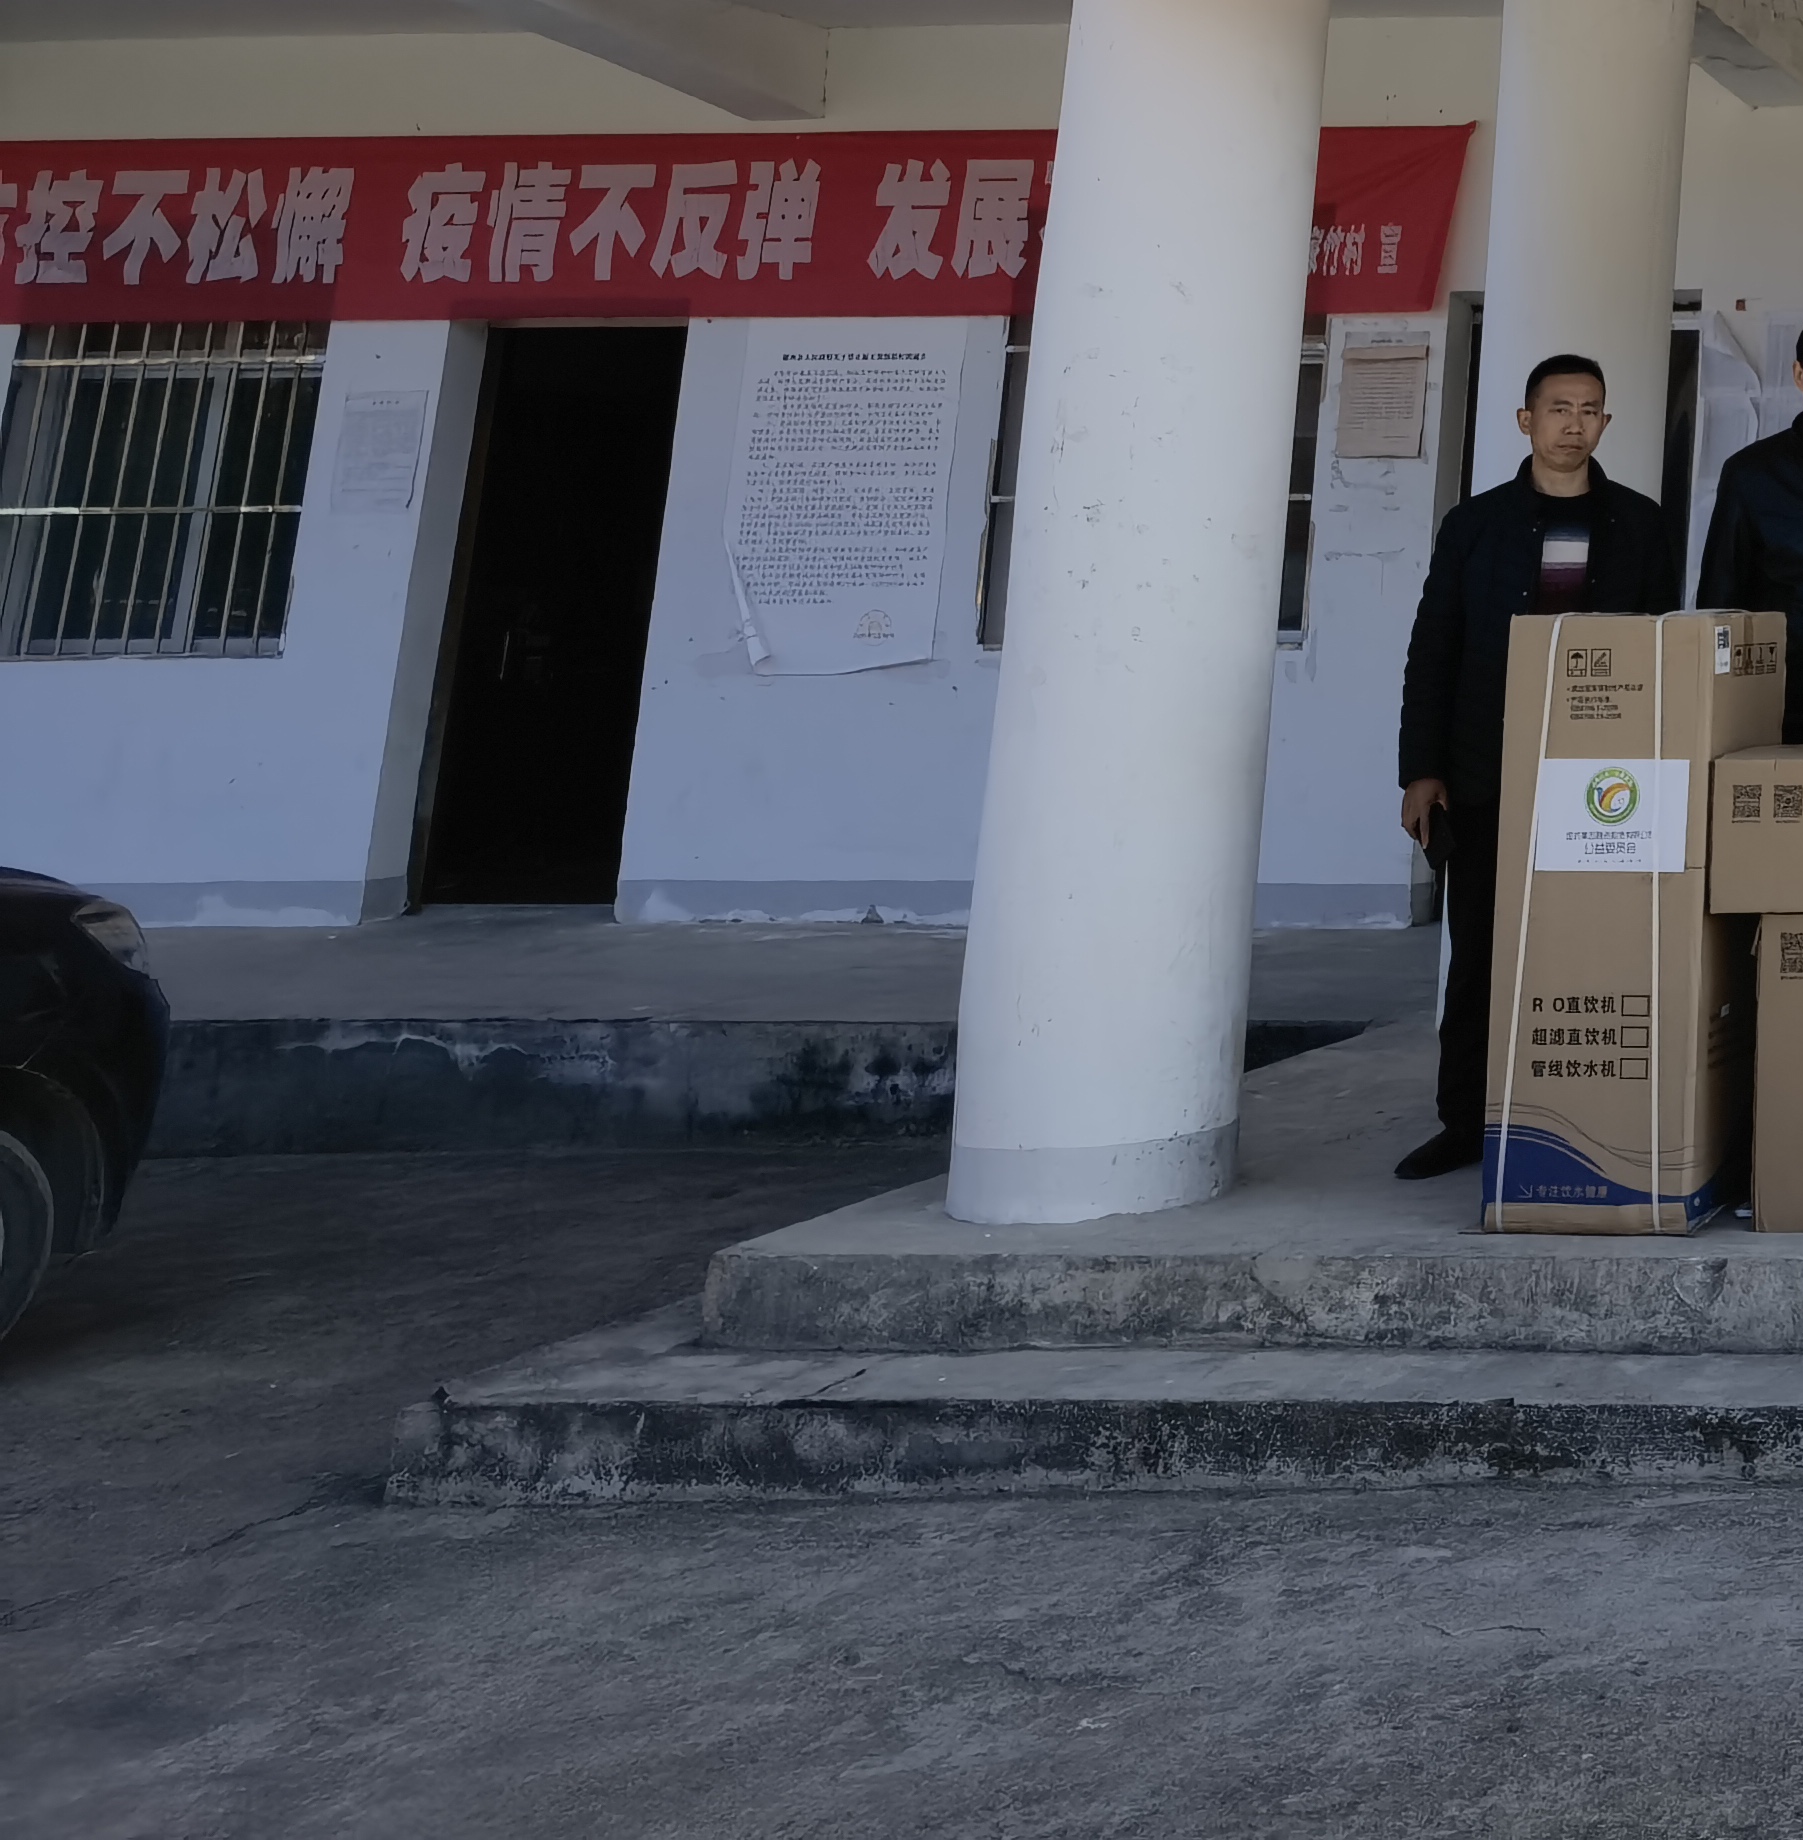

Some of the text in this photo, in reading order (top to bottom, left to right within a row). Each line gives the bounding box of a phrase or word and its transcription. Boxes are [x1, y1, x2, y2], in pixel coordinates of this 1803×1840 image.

[400, 157, 821, 284] 疫情不反弹
[867, 157, 1054, 281] 发展
[1531, 1027, 1618, 1046] 超滤直饮机
[1531, 1060, 1617, 1078] 管线饮水机
